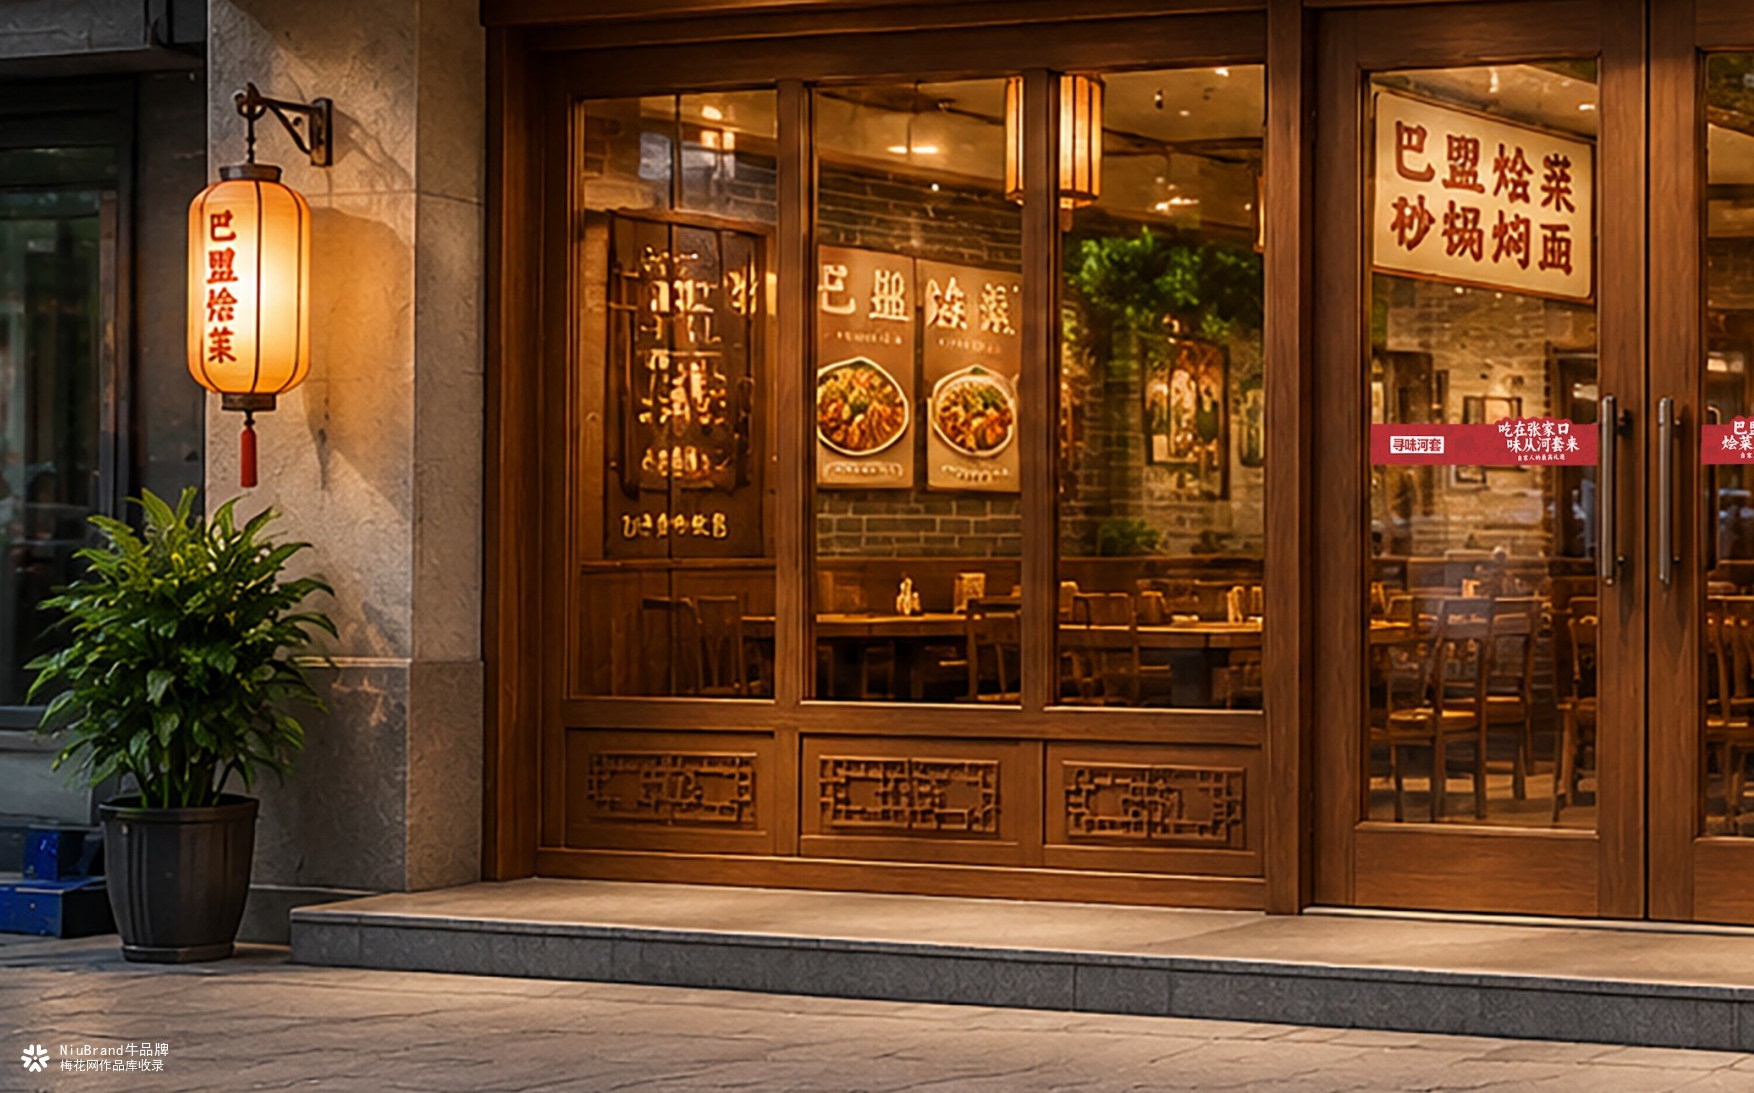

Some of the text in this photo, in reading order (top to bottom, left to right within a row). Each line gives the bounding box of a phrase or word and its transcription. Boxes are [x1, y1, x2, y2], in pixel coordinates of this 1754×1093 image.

[1498, 420, 1570, 438] 吃在张家口
[1392, 438, 1442, 452] 寻味河套
[1506, 435, 1580, 453] 味从河套来
